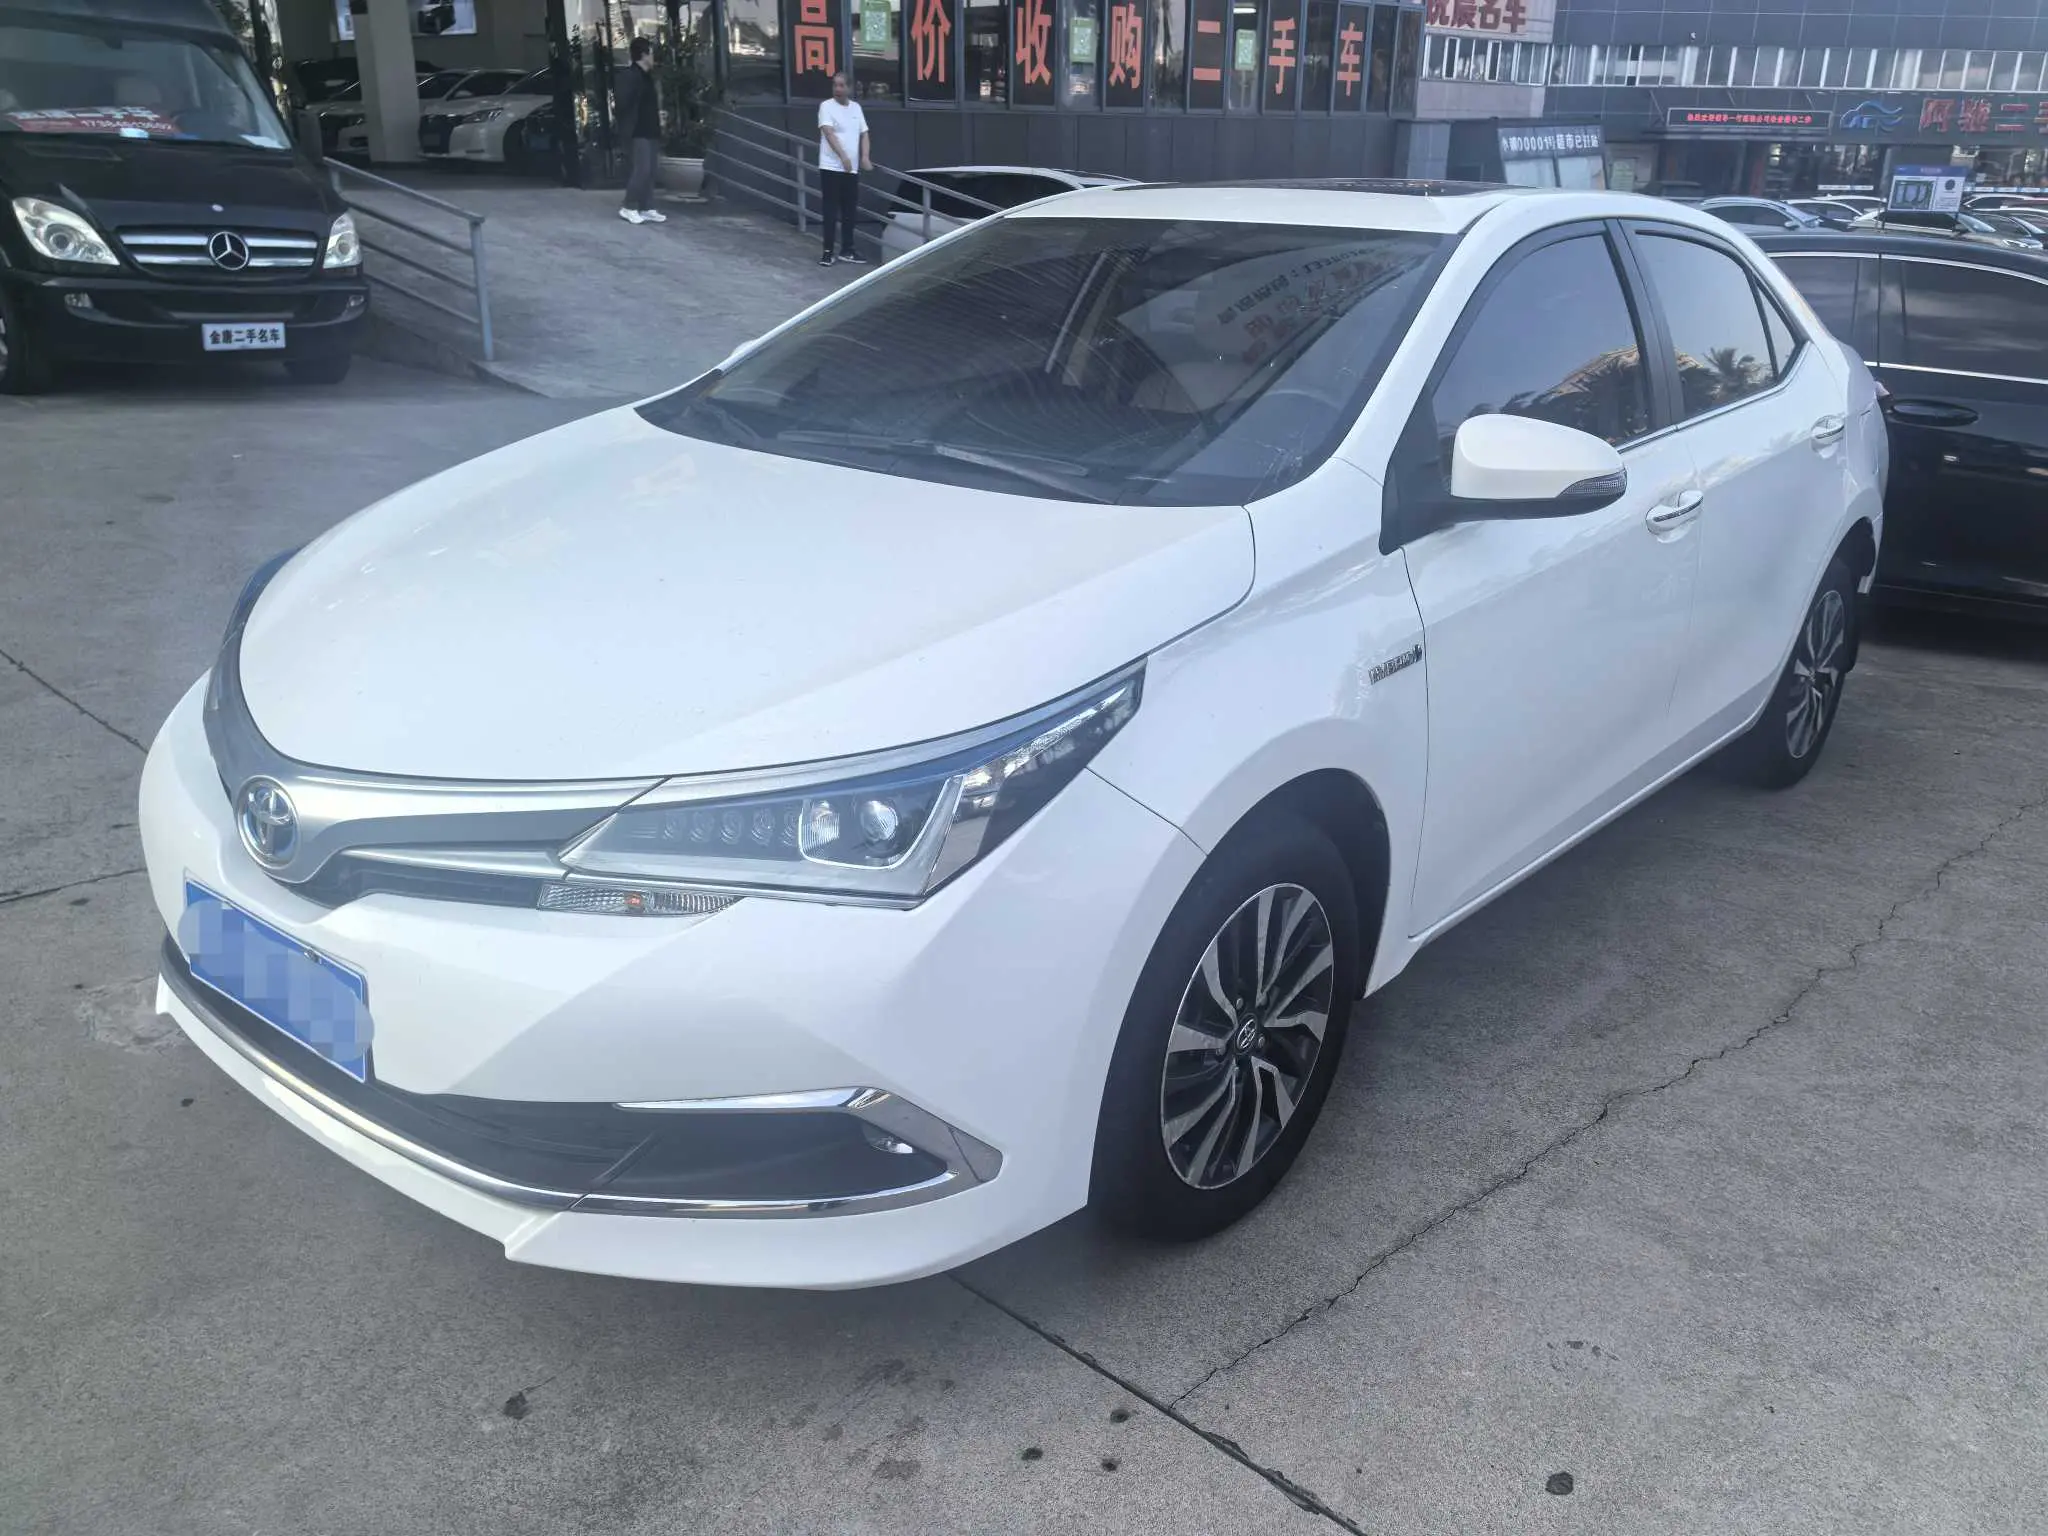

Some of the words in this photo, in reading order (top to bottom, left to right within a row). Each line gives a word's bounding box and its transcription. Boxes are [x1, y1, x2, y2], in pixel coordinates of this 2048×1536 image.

[794, 0, 1363, 96] 高价收购二手车
